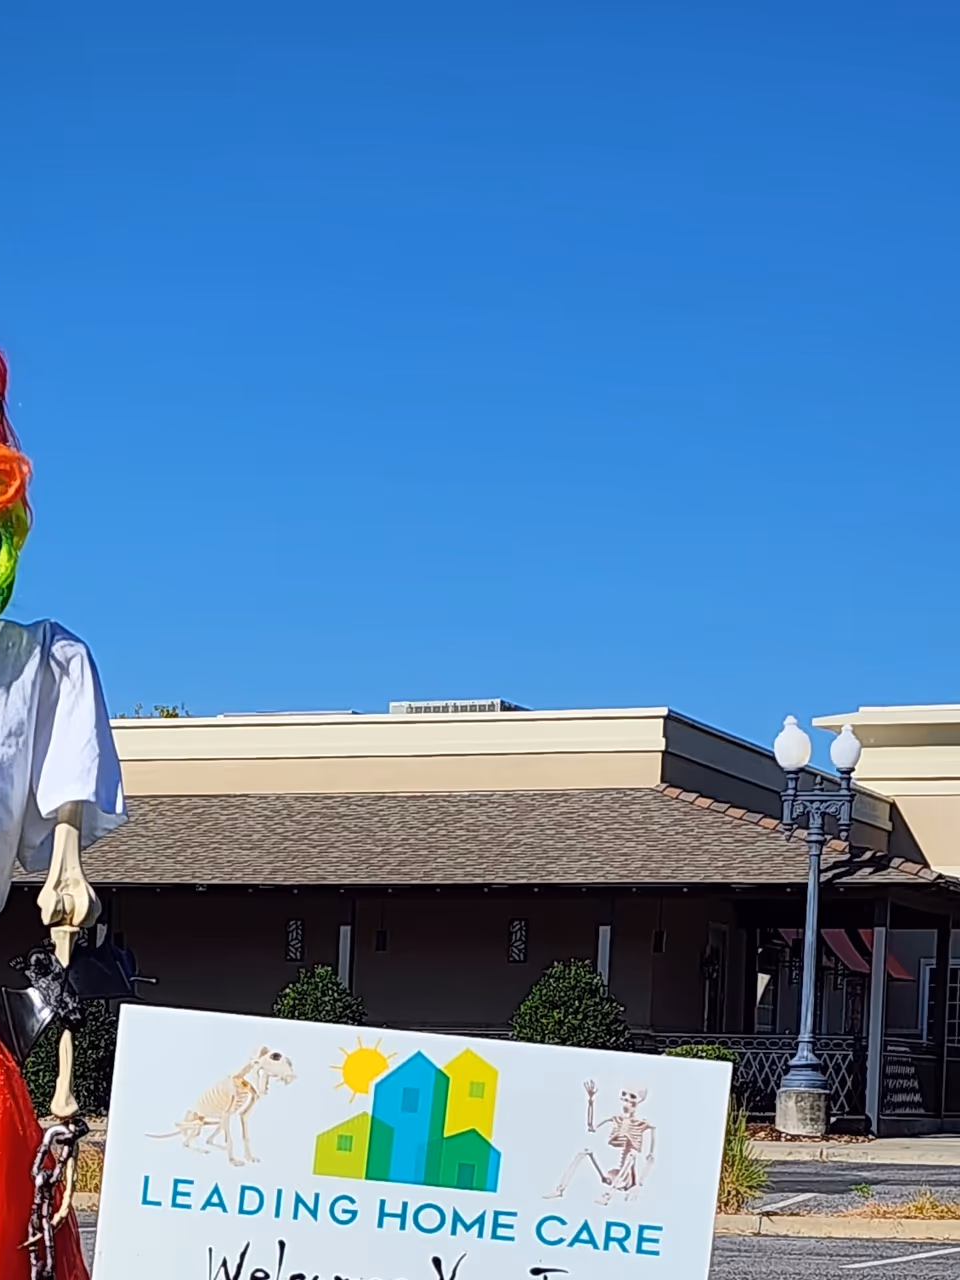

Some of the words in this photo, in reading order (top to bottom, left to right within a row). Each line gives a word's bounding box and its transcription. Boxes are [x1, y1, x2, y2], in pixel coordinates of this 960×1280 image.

[141, 1175, 359, 1226] LEADING
[376, 1198, 518, 1243] HOME
[535, 1214, 664, 1258] CARE
